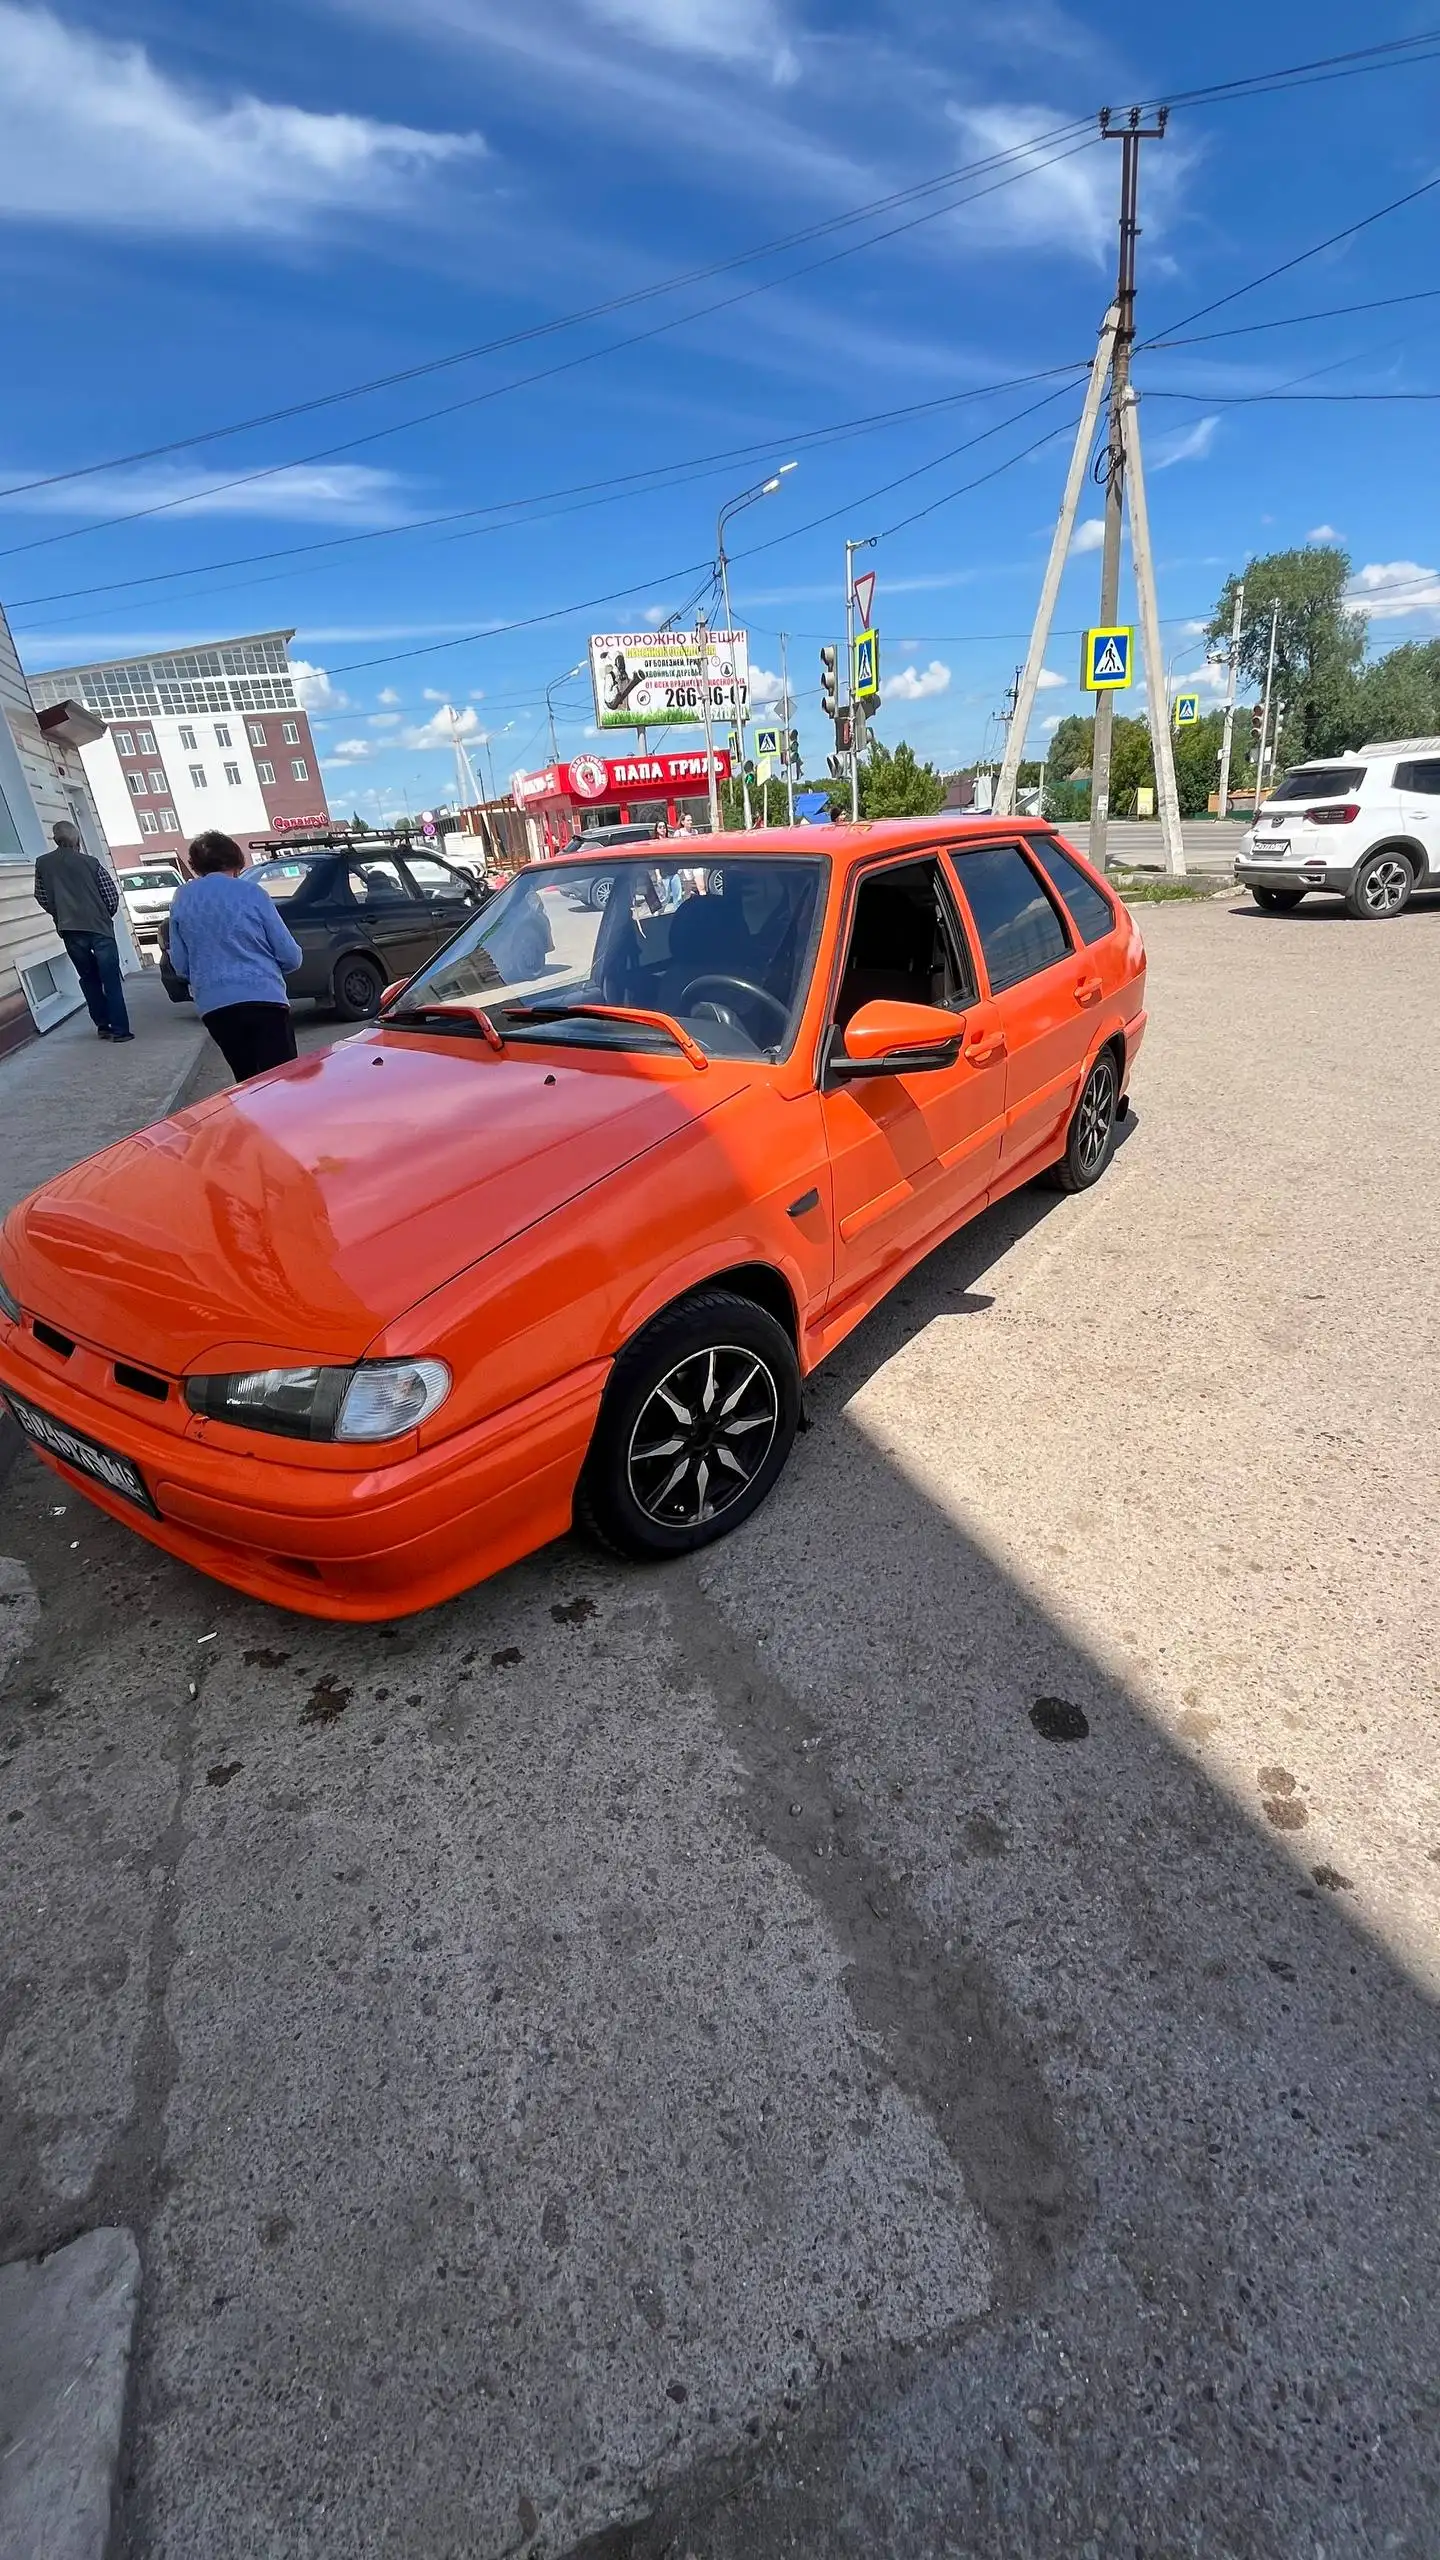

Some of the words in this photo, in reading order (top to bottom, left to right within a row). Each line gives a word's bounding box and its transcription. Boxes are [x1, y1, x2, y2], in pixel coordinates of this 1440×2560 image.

[594, 633, 686, 648] ОСТОРОЖНО
[644, 659, 652, 668] ОТ
[613, 762, 664, 782] ПАПА
[668, 757, 724, 777] ГРИЛЬ
